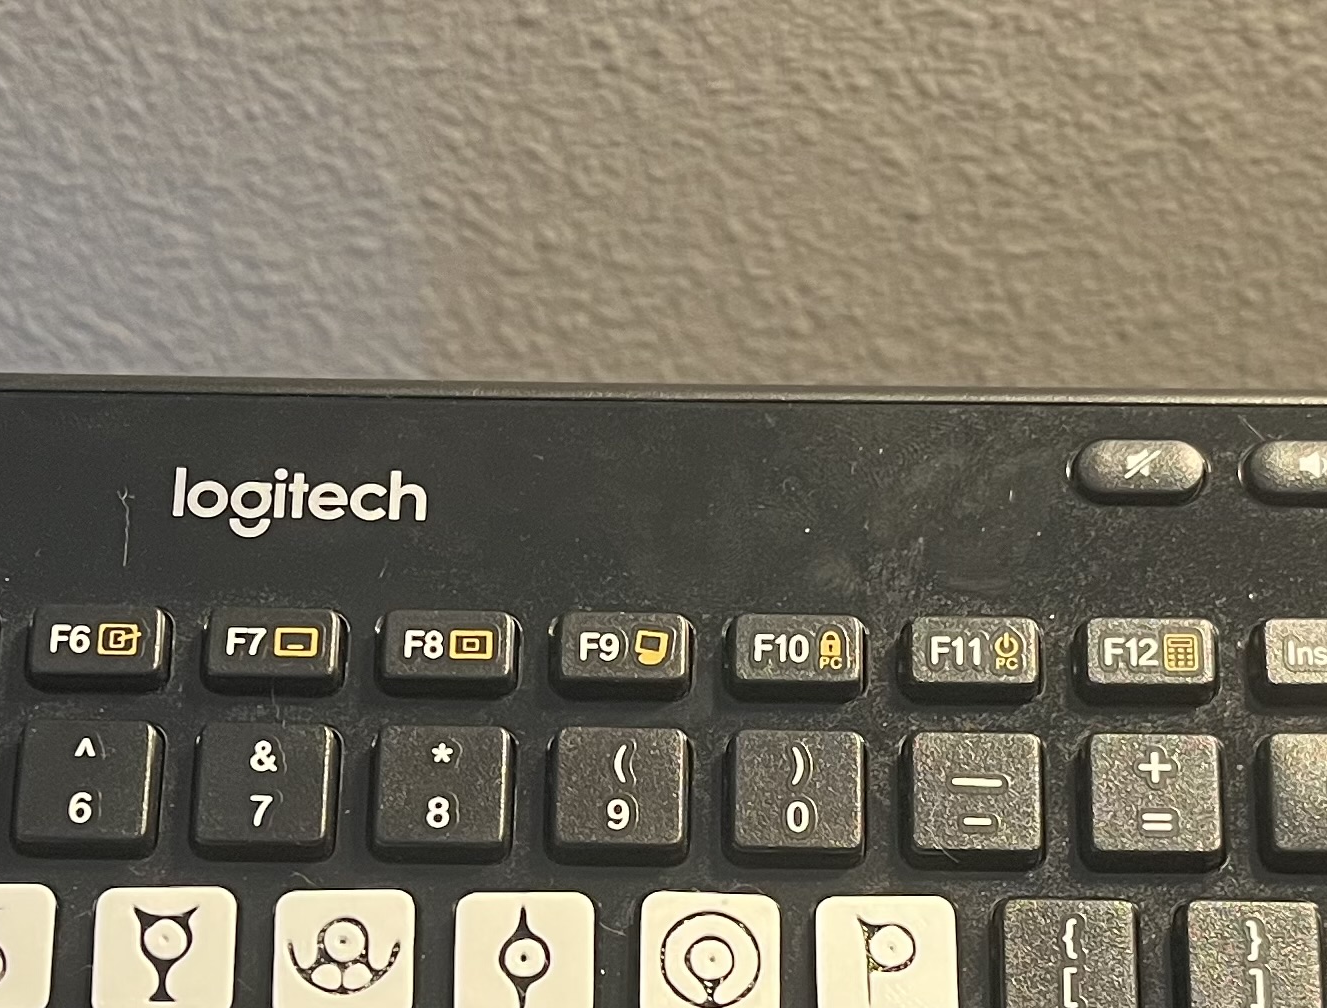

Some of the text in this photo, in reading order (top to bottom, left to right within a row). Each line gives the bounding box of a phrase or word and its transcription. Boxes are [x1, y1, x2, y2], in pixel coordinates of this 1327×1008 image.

[172, 466, 427, 538] logitech
[48, 624, 91, 654] F6
[225, 627, 266, 657] F7
[403, 629, 445, 660] F8
[579, 630, 619, 662] F9
[753, 633, 810, 665] F10
[930, 636, 981, 666] F11
[1103, 638, 1159, 668] F12
[819, 657, 842, 669] PC
[995, 657, 1019, 670] PC
[68, 792, 93, 823] 6
[249, 795, 273, 827] 7
[425, 798, 450, 829] 8
[607, 800, 631, 831] 9
[785, 802, 810, 834] 0
